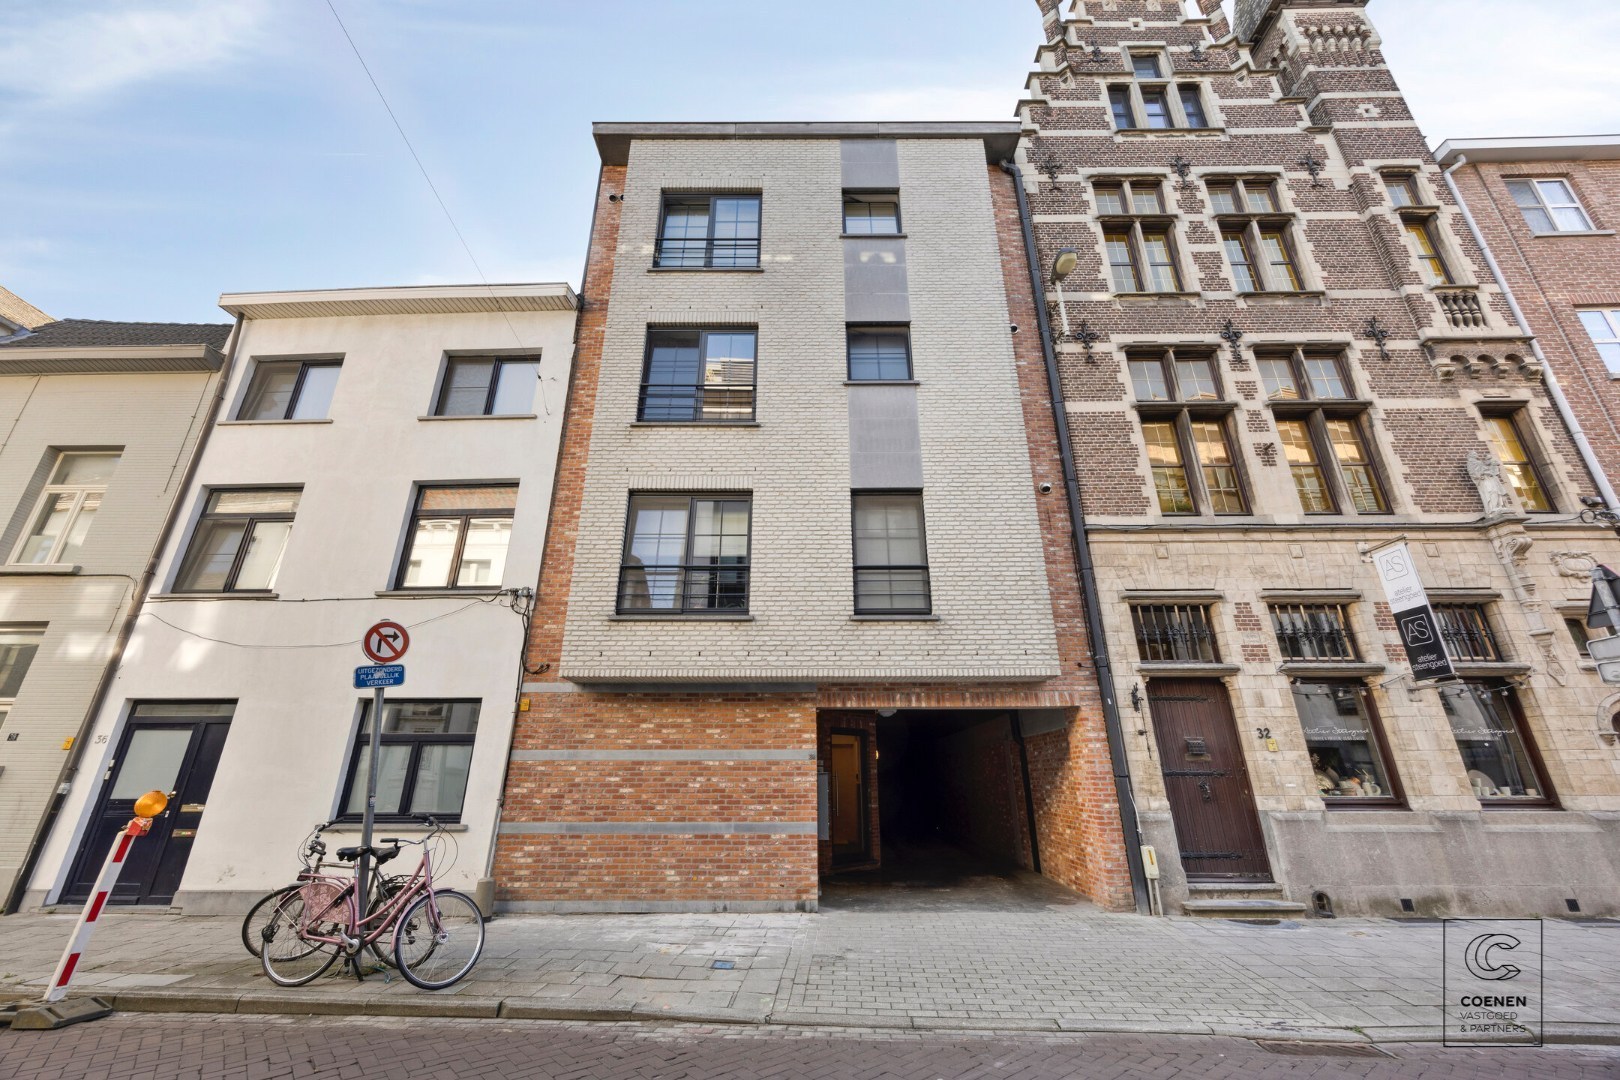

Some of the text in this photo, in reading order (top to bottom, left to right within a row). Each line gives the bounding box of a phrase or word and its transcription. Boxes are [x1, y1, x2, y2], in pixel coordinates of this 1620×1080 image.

[1386, 556, 1404, 576] AS
[1389, 590, 1421, 605] steengoed
[1394, 586, 1413, 597] atelier
[1408, 620, 1429, 642] AS
[1417, 653, 1437, 663] atelier
[1412, 658, 1448, 671] steengoed
[94, 734, 109, 744] 36
[1256, 727, 1272, 739] 32
